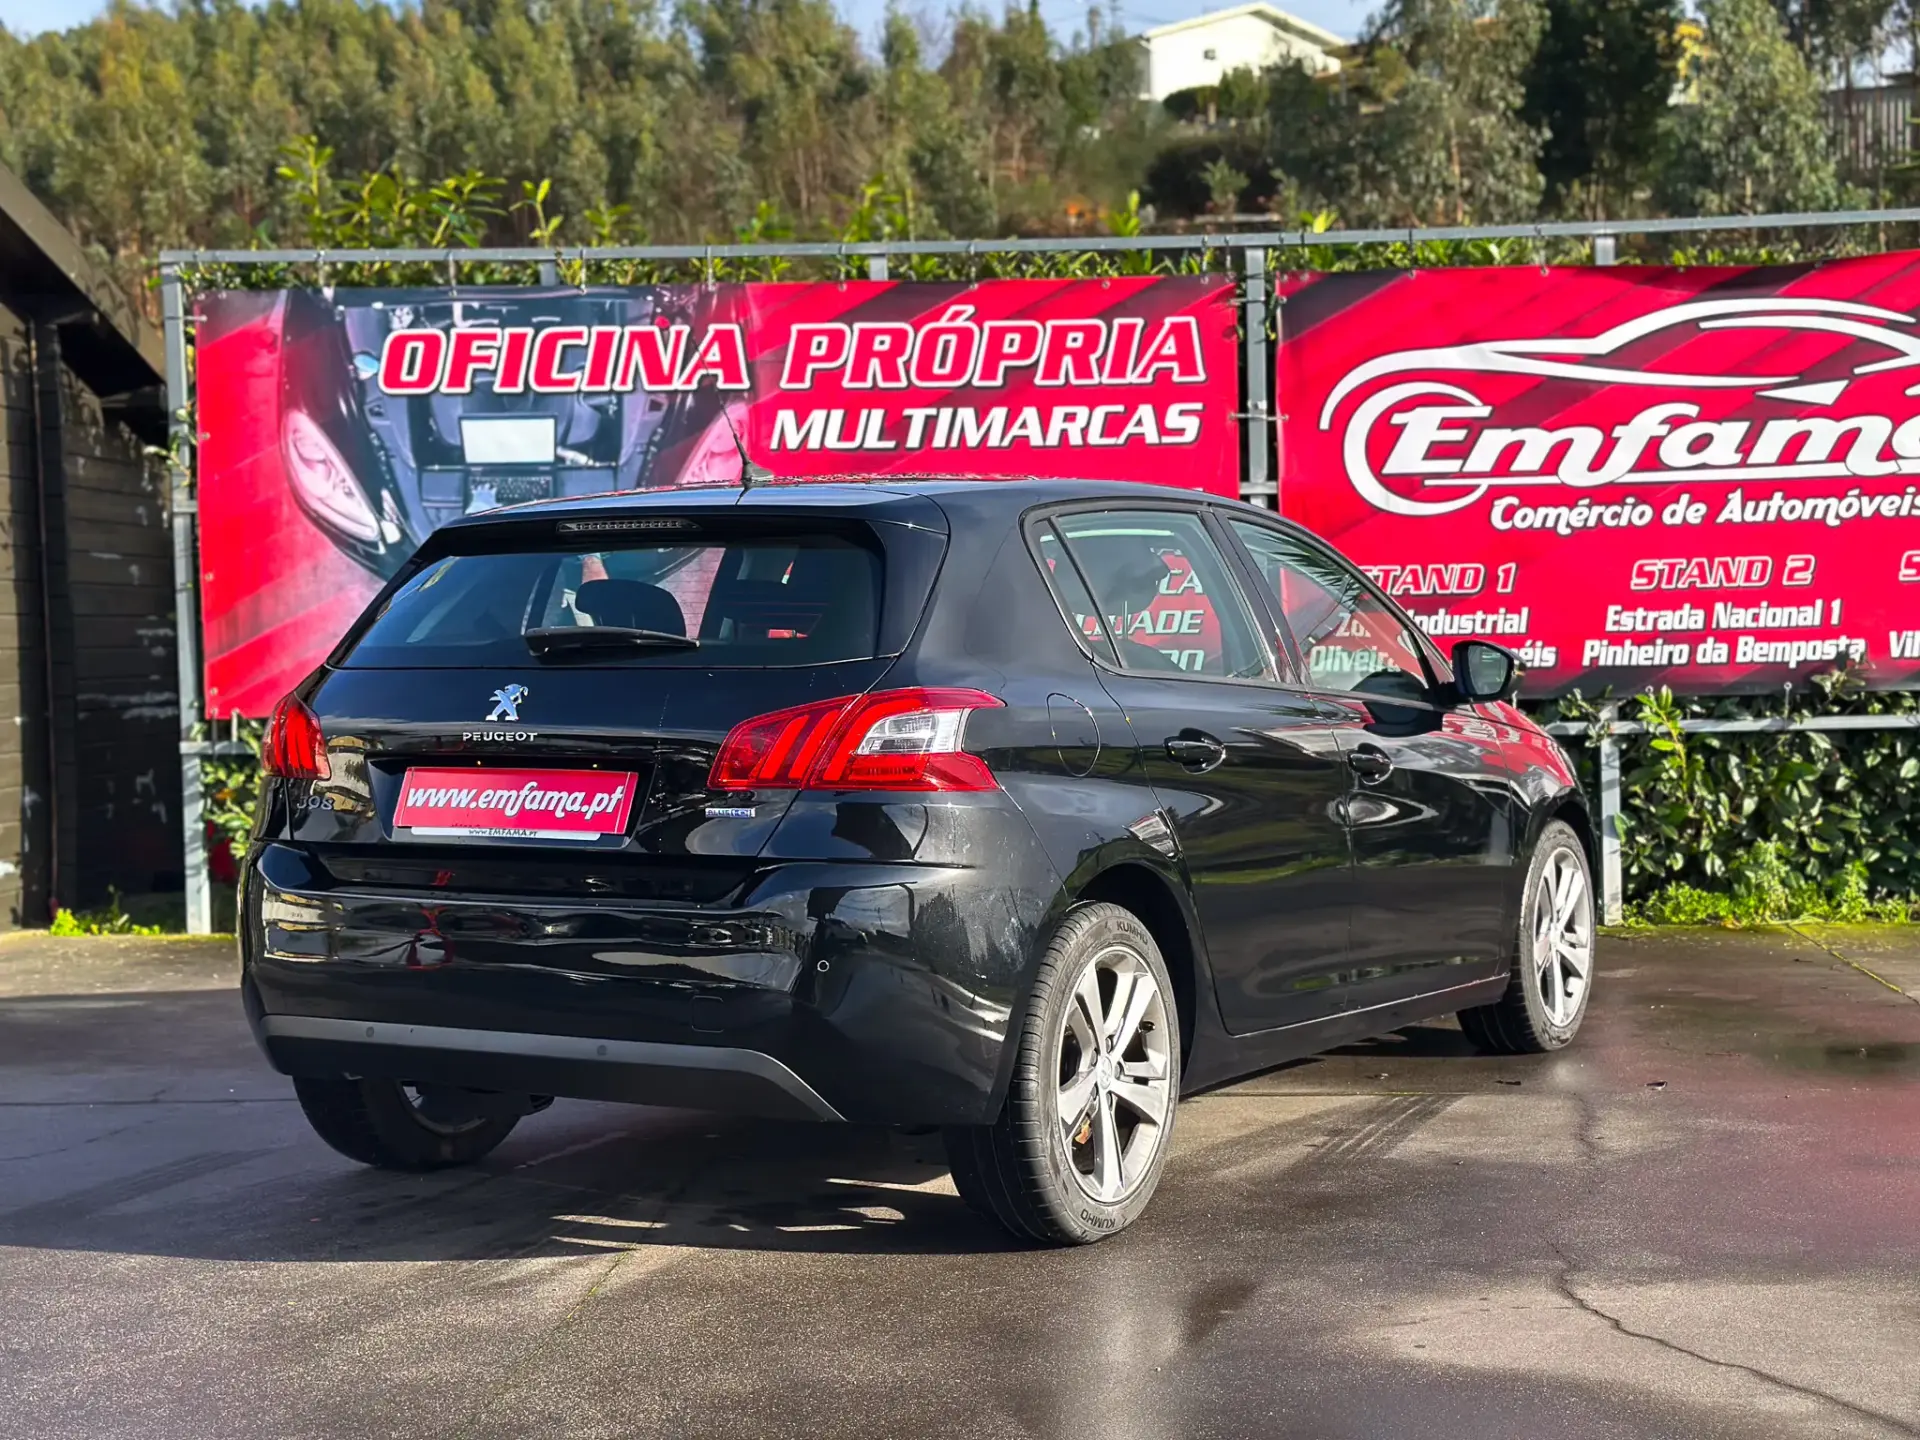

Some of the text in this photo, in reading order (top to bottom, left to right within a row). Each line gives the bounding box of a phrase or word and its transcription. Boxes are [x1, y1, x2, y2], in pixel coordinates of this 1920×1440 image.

[377, 305, 1207, 395] OFICINA PRÓPRIA
[770, 402, 1204, 450] MULTIMARCAS
[1490, 496, 1653, 534] Comércio
[1662, 494, 1707, 525] de
[1497, 563, 1517, 593] 1
[1630, 554, 1815, 590] STAND 2
[1605, 598, 1842, 632] Estrada Nacional 1
[1582, 635, 1866, 668] Pinheiro da Bemposta
[462, 731, 538, 742] PEUGEOT
[406, 781, 624, 820] www.emfama.pt
[1116, 920, 1149, 945] KUMHO
[1080, 1208, 1116, 1229] KUMHO
